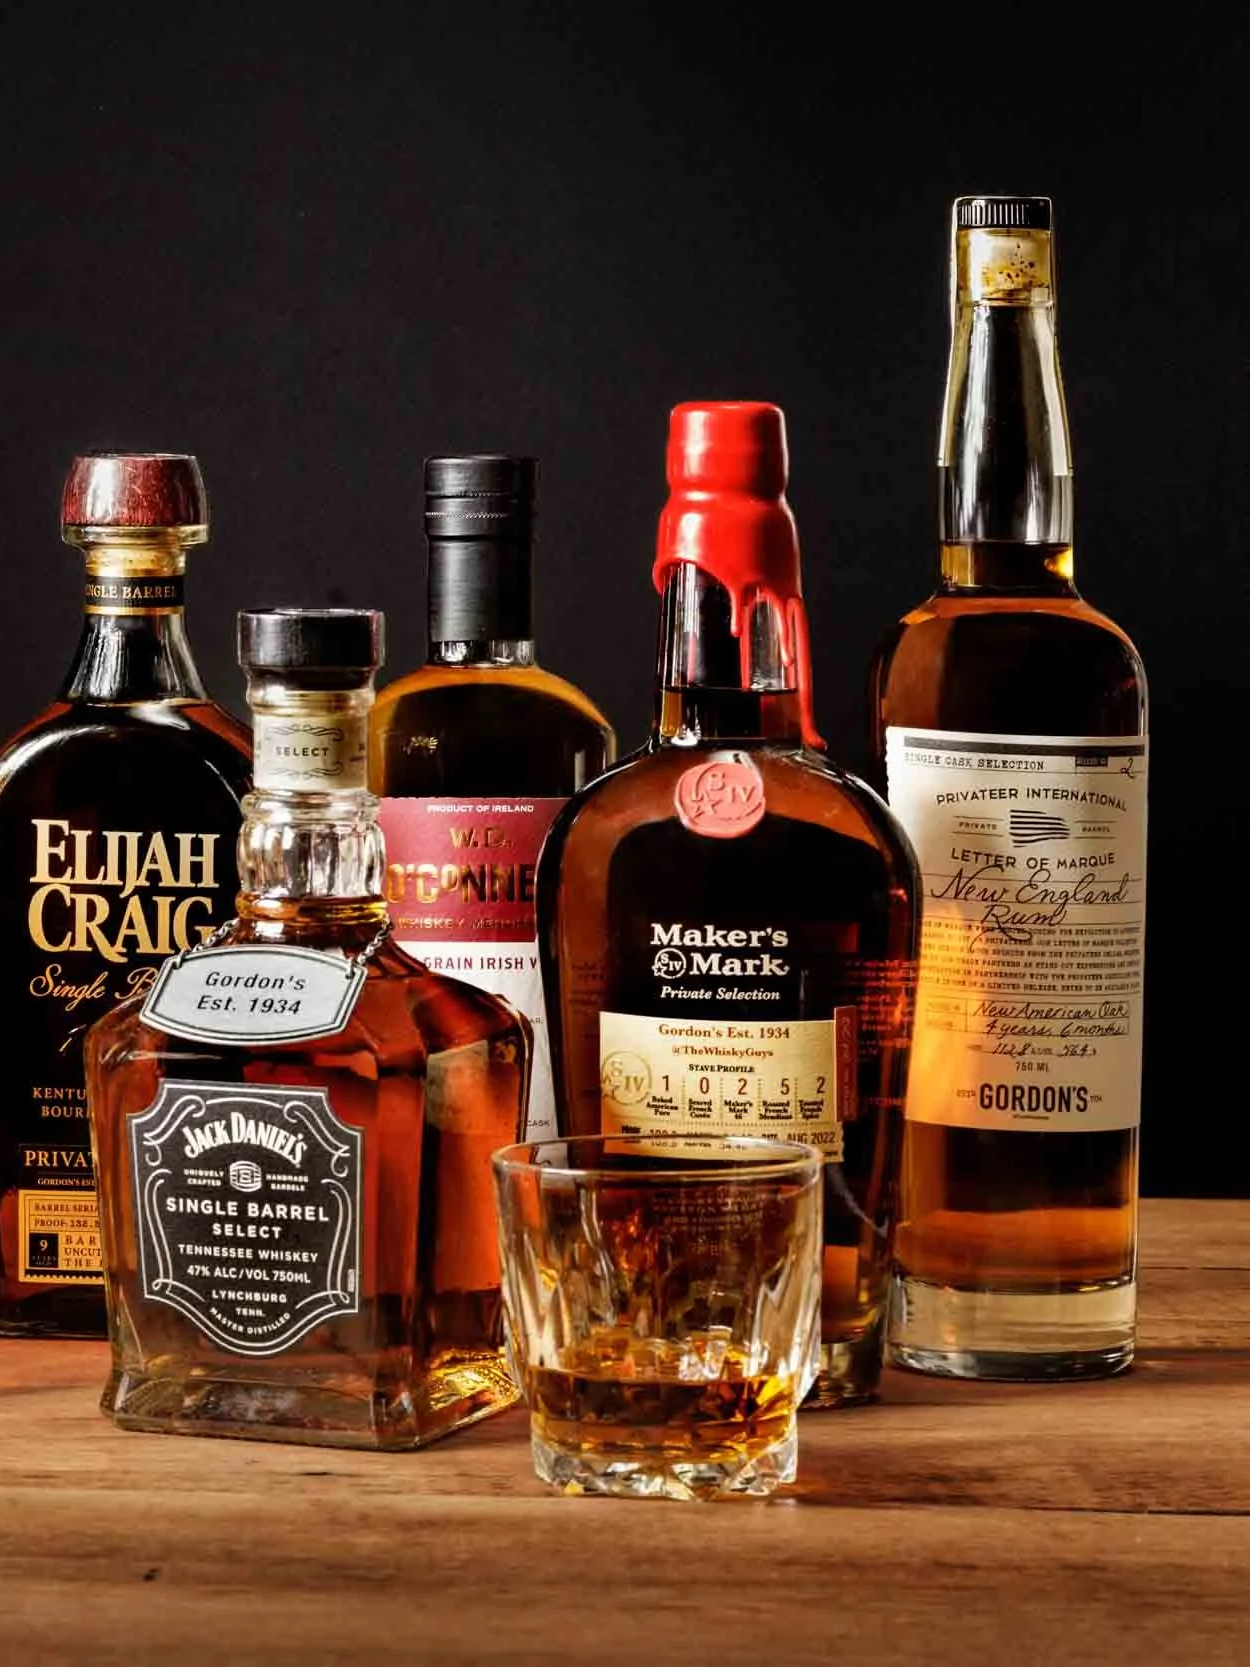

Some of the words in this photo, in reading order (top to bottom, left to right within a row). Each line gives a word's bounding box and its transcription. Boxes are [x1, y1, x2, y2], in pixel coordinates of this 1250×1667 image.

[122, 585, 177, 599] BARREL
[275, 746, 330, 757] SELECT
[945, 756, 972, 767] CASK
[977, 758, 1045, 771] SELECTION
[936, 787, 1019, 805] PRIVATEER
[1026, 786, 1127, 812] INTERNATIONAL
[427, 804, 474, 813] PRODUCT
[476, 804, 490, 813] OF
[492, 804, 535, 813] IRELAND
[958, 821, 998, 831] PRIVATE
[29, 818, 221, 899] ELIJAH
[950, 847, 1017, 867] LETTER
[1026, 856, 1050, 871] OF
[1057, 852, 1117, 870] MARQUE
[386, 863, 536, 905] O'CONNE
[930, 863, 1008, 902] New
[1014, 868, 1130, 913] England
[28, 882, 217, 964] CRAIG
[650, 922, 790, 948] Maker's
[424, 956, 473, 970] GRAIN
[480, 956, 525, 970] IRISH
[688, 952, 791, 977] Mark
[29, 963, 109, 1012] Single
[205, 970, 307, 992] Gordon's
[660, 984, 713, 1000] Private
[716, 986, 781, 1001] Selection
[197, 995, 238, 1013] Est.
[250, 997, 303, 1016] 1934
[1017, 1002, 1096, 1020] American
[1098, 1001, 1127, 1018] Oak
[658, 1022, 724, 1040] Gordon's
[727, 1025, 755, 1040] Est.
[758, 1026, 791, 1040] 1934
[671, 1045, 774, 1059] @TheWhiskyGuys
[688, 1063, 716, 1073] STAVE
[717, 1064, 756, 1074] PROFILE
[33, 1087, 87, 1101] KENTU
[661, 1075, 670, 1093] 1
[699, 1076, 710, 1095] 0
[737, 1078, 748, 1096] 2
[779, 1078, 791, 1096] 5
[816, 1076, 826, 1095] 2
[979, 1082, 1089, 1113] GORDON'S
[40, 1105, 90, 1119] BOUR
[182, 1120, 230, 1159] JACK
[230, 1111, 308, 1168] DANIEL'S
[810, 1130, 836, 1145] 2022
[24, 1150, 97, 1168] PRIVAT
[182, 1168, 224, 1178] UNIQUELY
[265, 1173, 309, 1183] HANDMADE
[37, 1177, 81, 1187] GORDON'S
[187, 1178, 222, 1187] CRAFTED
[270, 1183, 305, 1192] BARRELS
[166, 1197, 238, 1217] SINGLE
[247, 1202, 330, 1222] BARREL
[212, 1223, 282, 1239] SELECT
[38, 1239, 49, 1252] 9
[177, 1243, 254, 1259] TENNESSEE
[258, 1249, 319, 1263] WHISKEY
[186, 1264, 211, 1278] 47%
[213, 1266, 271, 1281] ALC/VOL
[272, 1269, 311, 1284] 750ML
[211, 1289, 288, 1304] LYNCHBURG
[209, 1306, 245, 1333] MASTER
[246, 1311, 292, 1335] DISTILLED
[235, 1307, 267, 1318] TENN.
